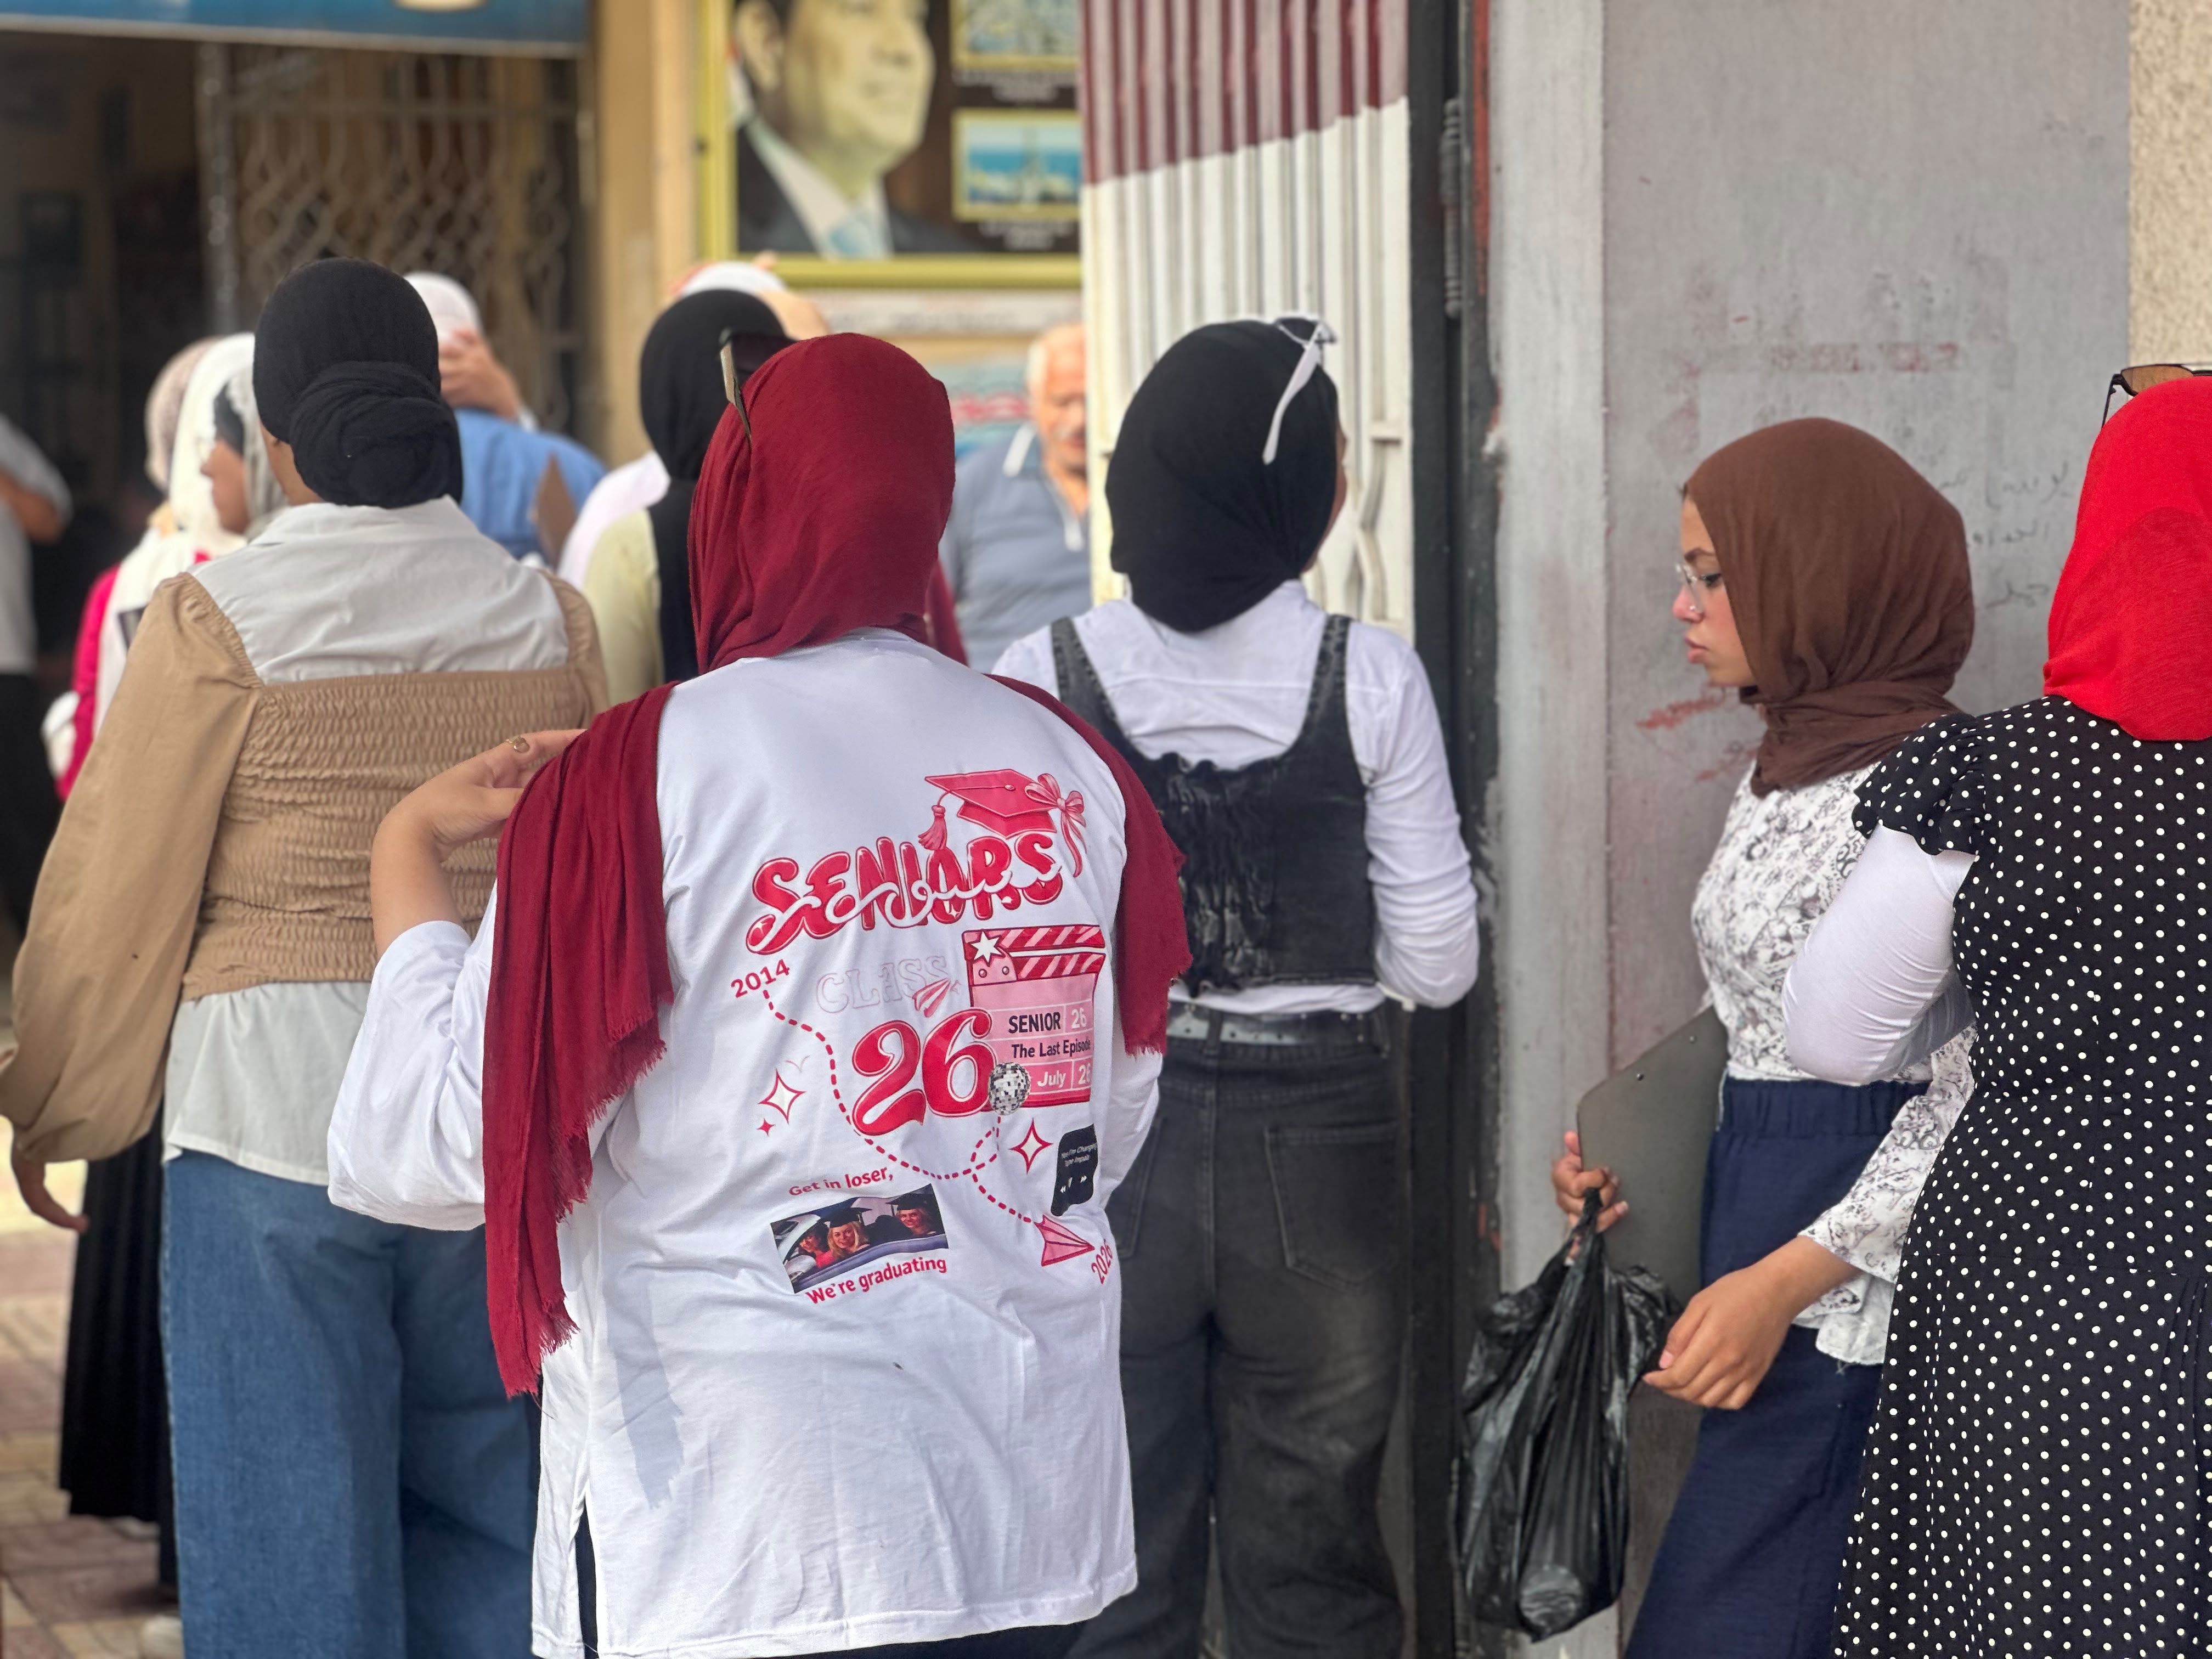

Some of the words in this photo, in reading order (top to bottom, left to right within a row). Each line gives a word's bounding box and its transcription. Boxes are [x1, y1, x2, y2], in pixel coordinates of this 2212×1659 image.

[746, 833, 1063, 955] SENIORS
[731, 958, 791, 998] 2014
[1008, 1012, 1061, 1034] SENIOR
[1071, 1007, 1087, 1030] 26
[1011, 1043, 1035, 1059] The
[1039, 1042, 1060, 1057] Last
[852, 1008, 998, 1136] 26
[1037, 1070, 1066, 1088] July
[789, 1181, 821, 1196] Get
[825, 1179, 842, 1189] in
[845, 1166, 894, 1188] loser,
[805, 1279, 856, 1305] We're
[858, 1256, 947, 1293] graduating
[1091, 1238, 1113, 1285] 2026
